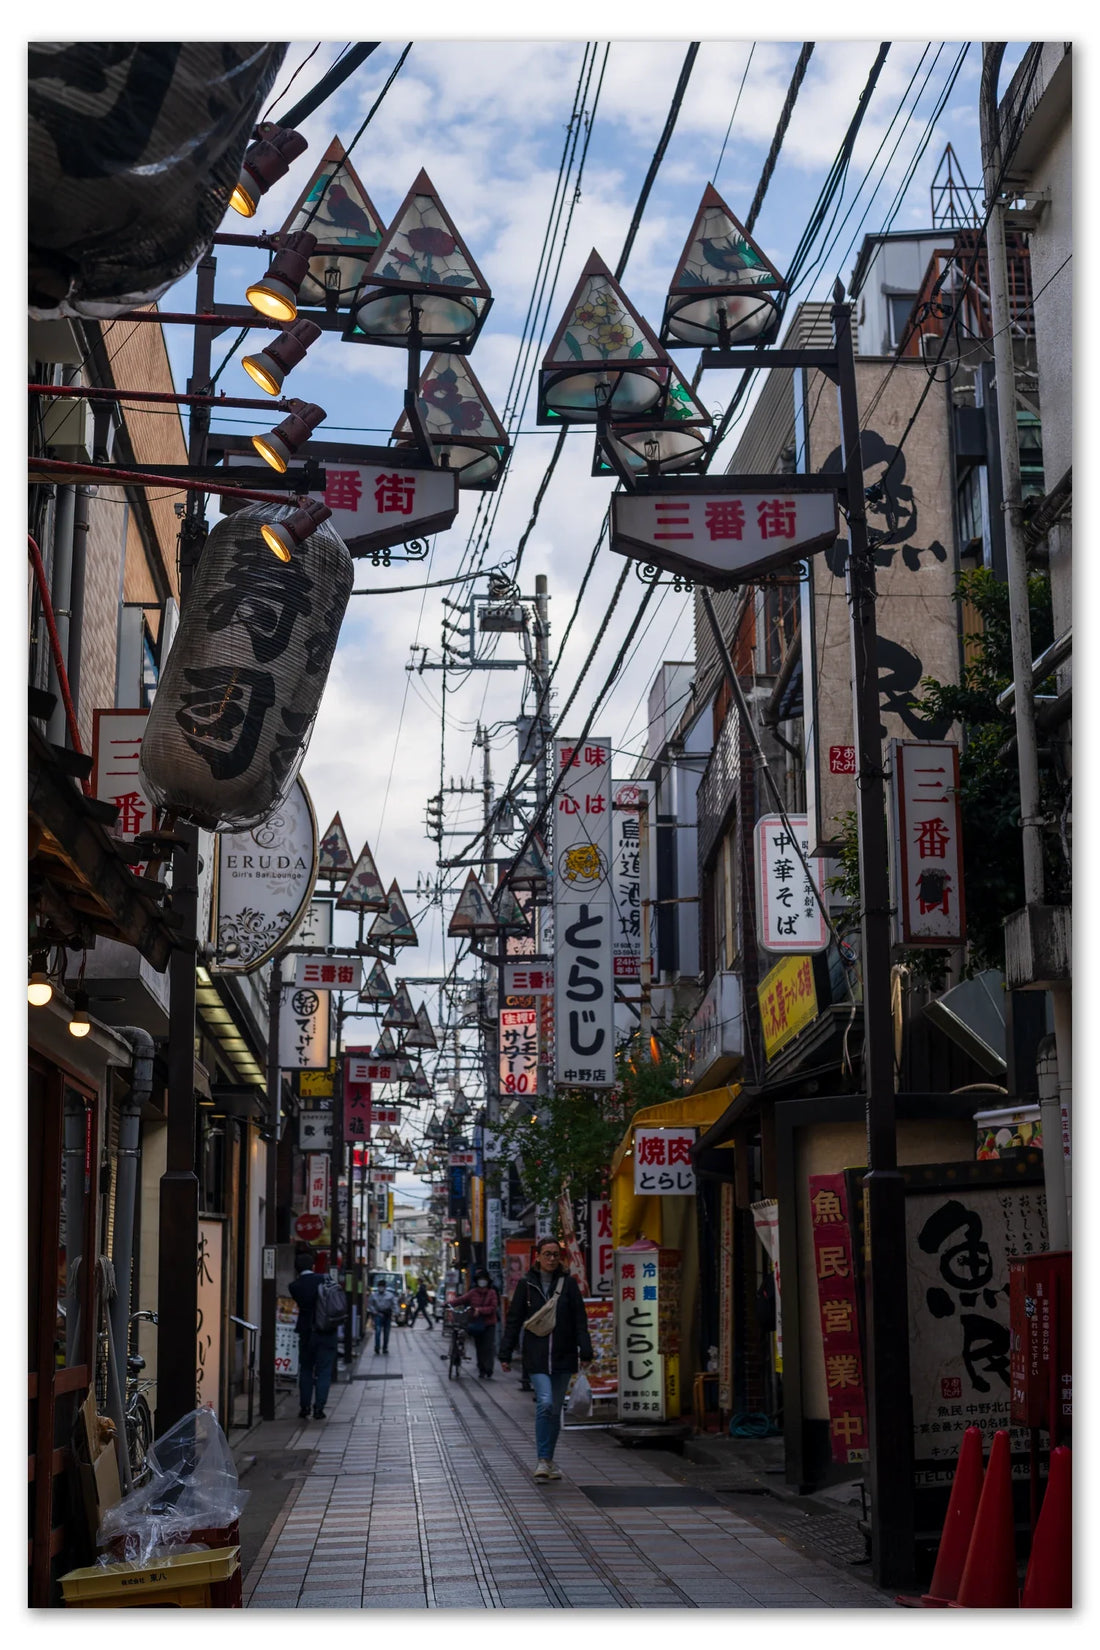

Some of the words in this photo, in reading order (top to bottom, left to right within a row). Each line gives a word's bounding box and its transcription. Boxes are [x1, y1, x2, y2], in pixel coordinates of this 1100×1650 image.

[322, 470, 416, 515] 番街
[654, 500, 798, 543] 三番街
[227, 855, 307, 869] ERUDA
[232, 871, 253, 879] Girl's
[772, 832, 800, 938] 中華そば
[304, 965, 354, 983] 三番街
[565, 904, 604, 1056] とらじ
[295, 1018, 314, 1066] てけてけ
[356, 1065, 391, 1079] 三番街
[564, 1069, 606, 1081] 中野店
[638, 1136, 693, 1166] 焼肉
[640, 1172, 692, 1189] とらじ
[812, 1189, 864, 1446] 魚民営業中
[626, 1307, 654, 1381] とらじ
[623, 1401, 660, 1412] 中野本店
[937, 1405, 963, 1418] 魚民
